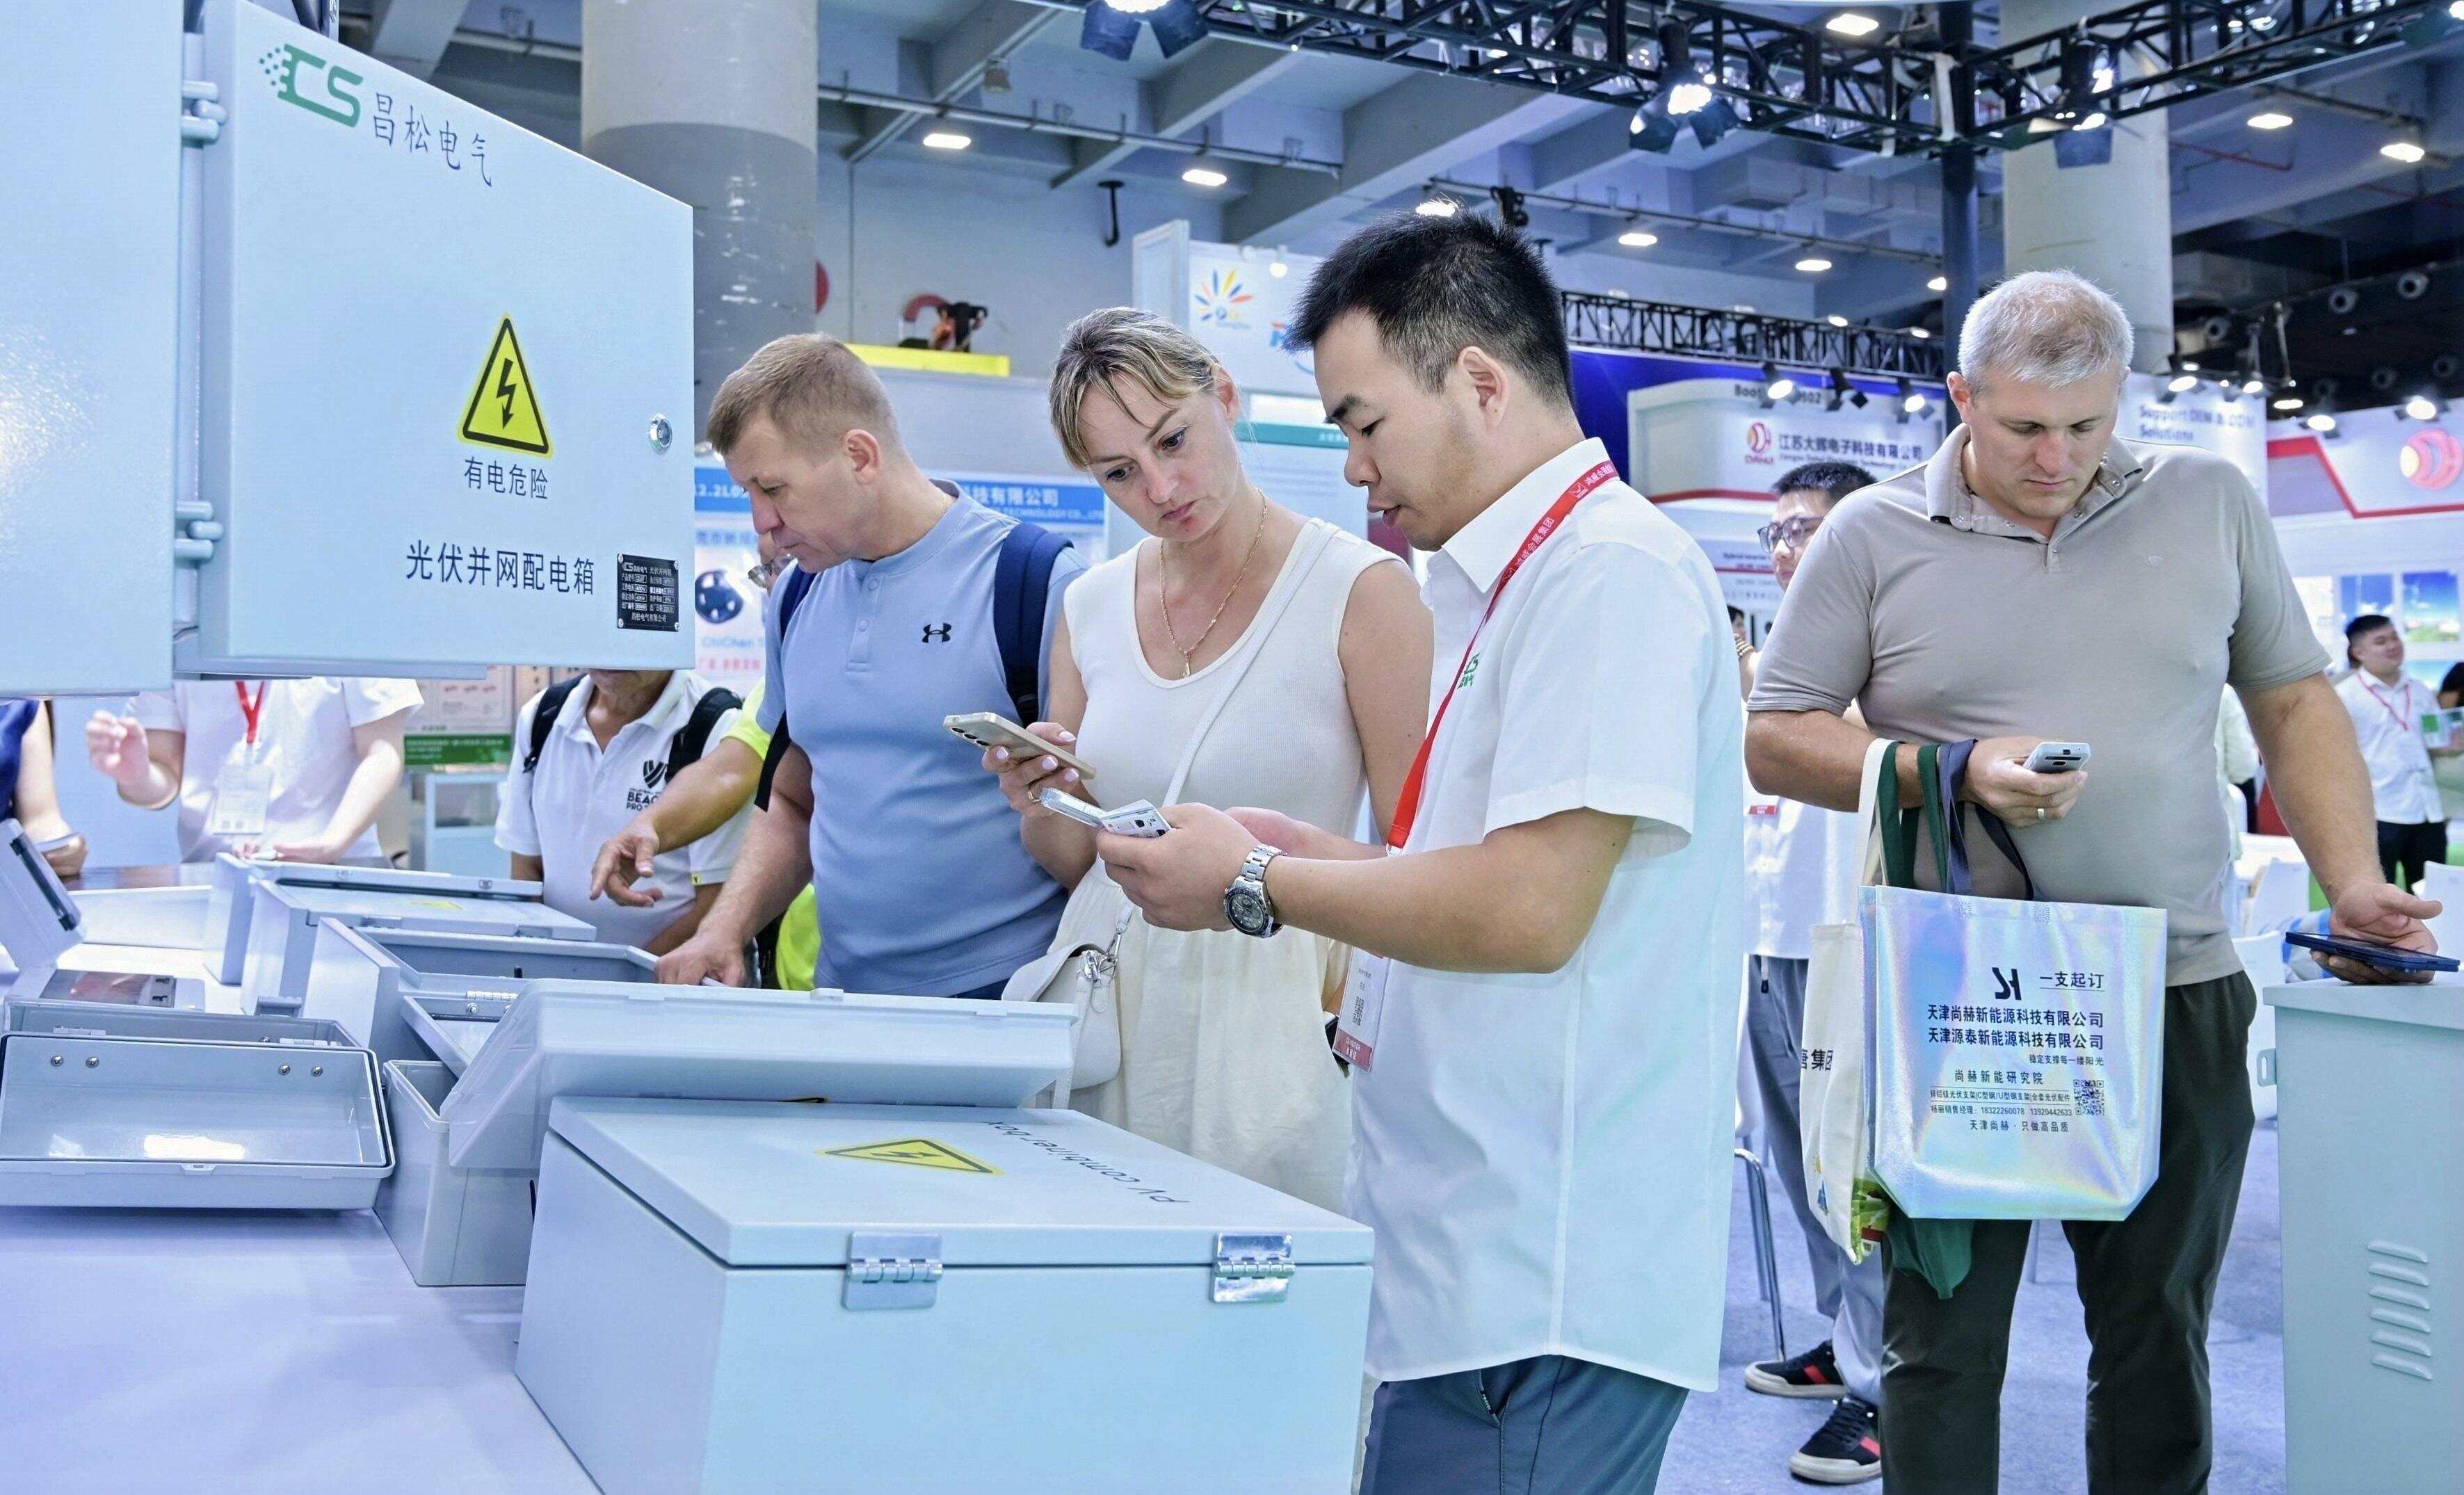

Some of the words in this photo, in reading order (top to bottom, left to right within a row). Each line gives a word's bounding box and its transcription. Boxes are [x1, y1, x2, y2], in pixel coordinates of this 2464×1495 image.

[278, 44, 364, 128] CS
[373, 92, 492, 187] 昌松电气
[465, 456, 548, 499] 有电危险
[406, 540, 594, 595] 光伏并网配电箱
[626, 802, 643, 811] PRO
[2039, 971, 2104, 989] 一支起订
[1928, 1004, 2103, 1028] 天津尚赫新能源科技有限公司
[1928, 1027, 2104, 1050] 天津源泰新能源科技有限公司
[1954, 1069, 2044, 1085] 尚赫新能研究院
[1981, 1107, 2025, 1115] 18322260078
[1127, 1186, 1190, 1203] PV
